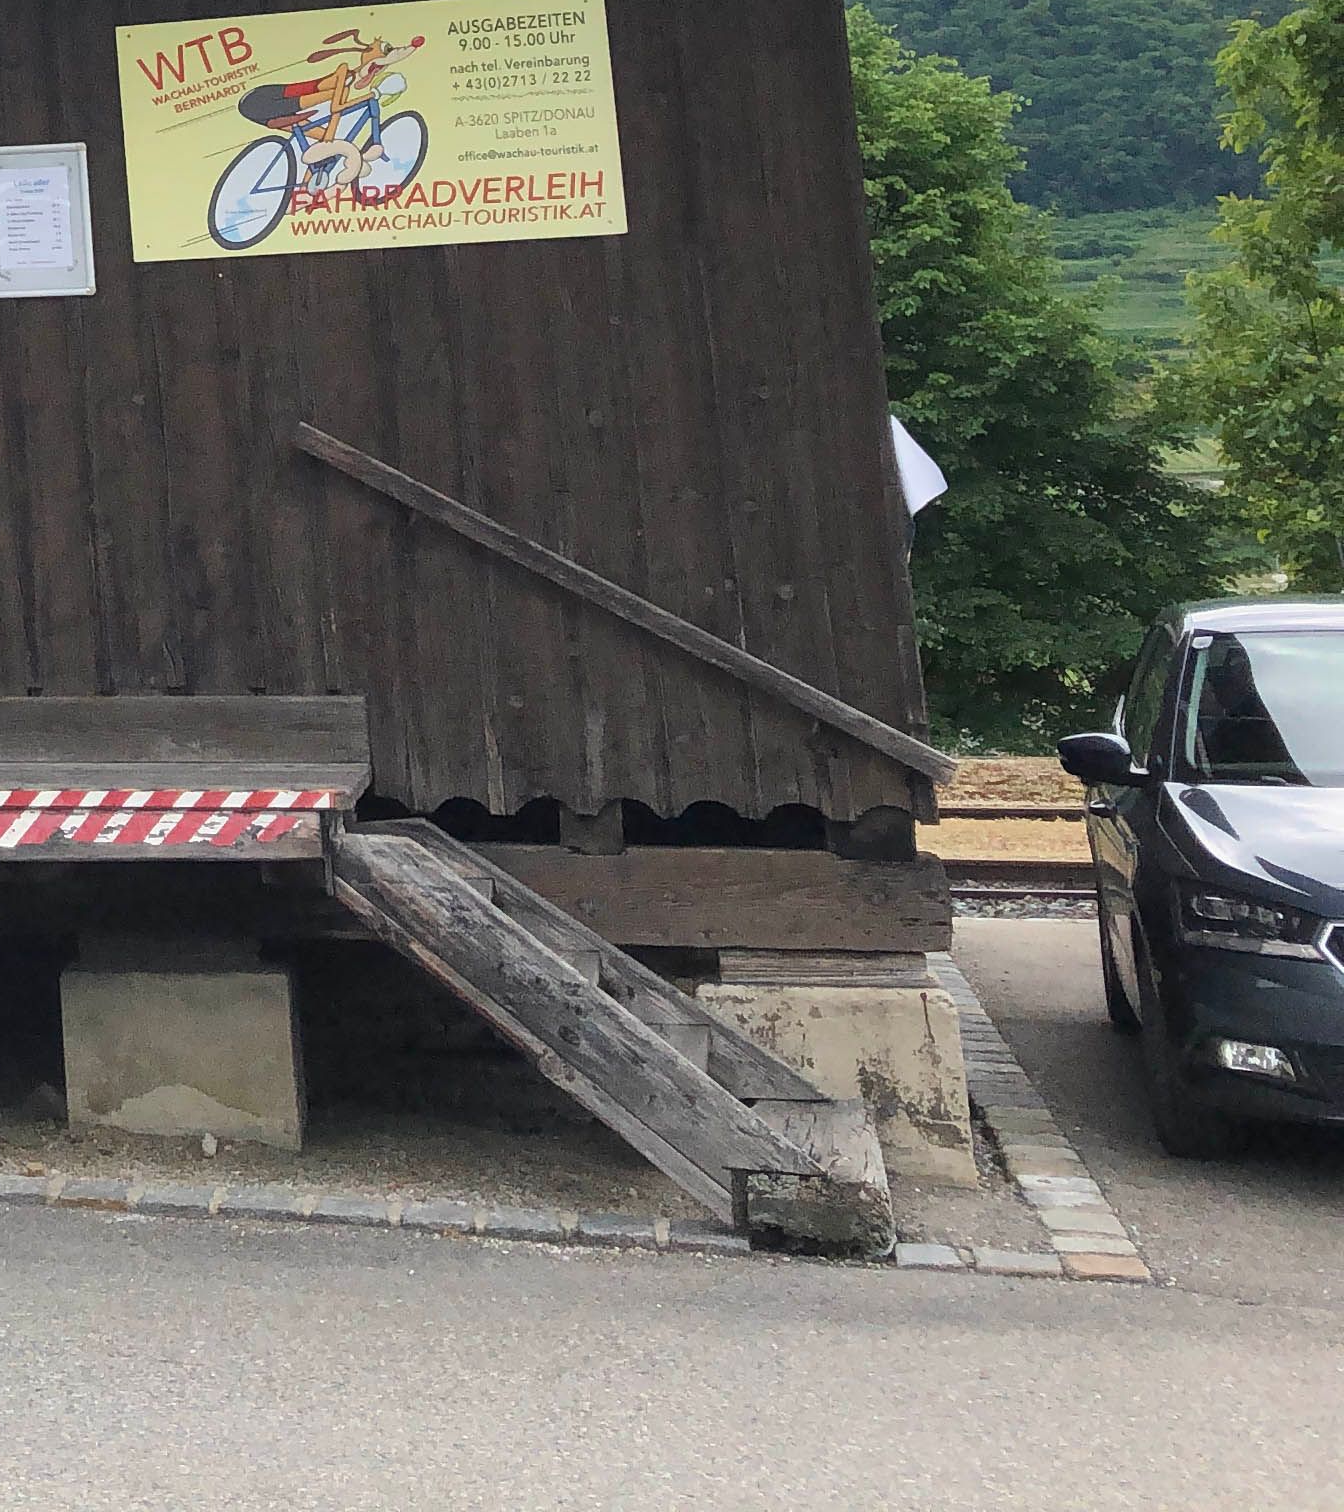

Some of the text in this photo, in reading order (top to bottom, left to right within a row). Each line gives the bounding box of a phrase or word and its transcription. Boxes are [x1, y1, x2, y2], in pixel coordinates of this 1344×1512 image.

[447, 11, 586, 35] AUSGABEZEITEN
[458, 37, 491, 51] 9.00
[504, 32, 546, 47] 15.00
[549, 31, 576, 44] Uhr
[136, 26, 253, 90] WTB
[450, 55, 590, 74] nach tel. Vereinbarung
[152, 63, 260, 106] WACHAU-TOURISTIK
[465, 74, 537, 90] 43(0)2713
[552, 72, 569, 83] 22
[575, 70, 591, 81] 22
[174, 82, 247, 113] BERNHARDT
[455, 106, 595, 127] A-3620 SPITZ/DONAU
[495, 125, 557, 139] Laaben 1a
[458, 144, 599, 161] office@wachau-touristik.at
[290, 170, 604, 216] FAHRRADVERLEIH
[291, 202, 607, 236] WWW.WACHAU-TOURISTIK.AT
